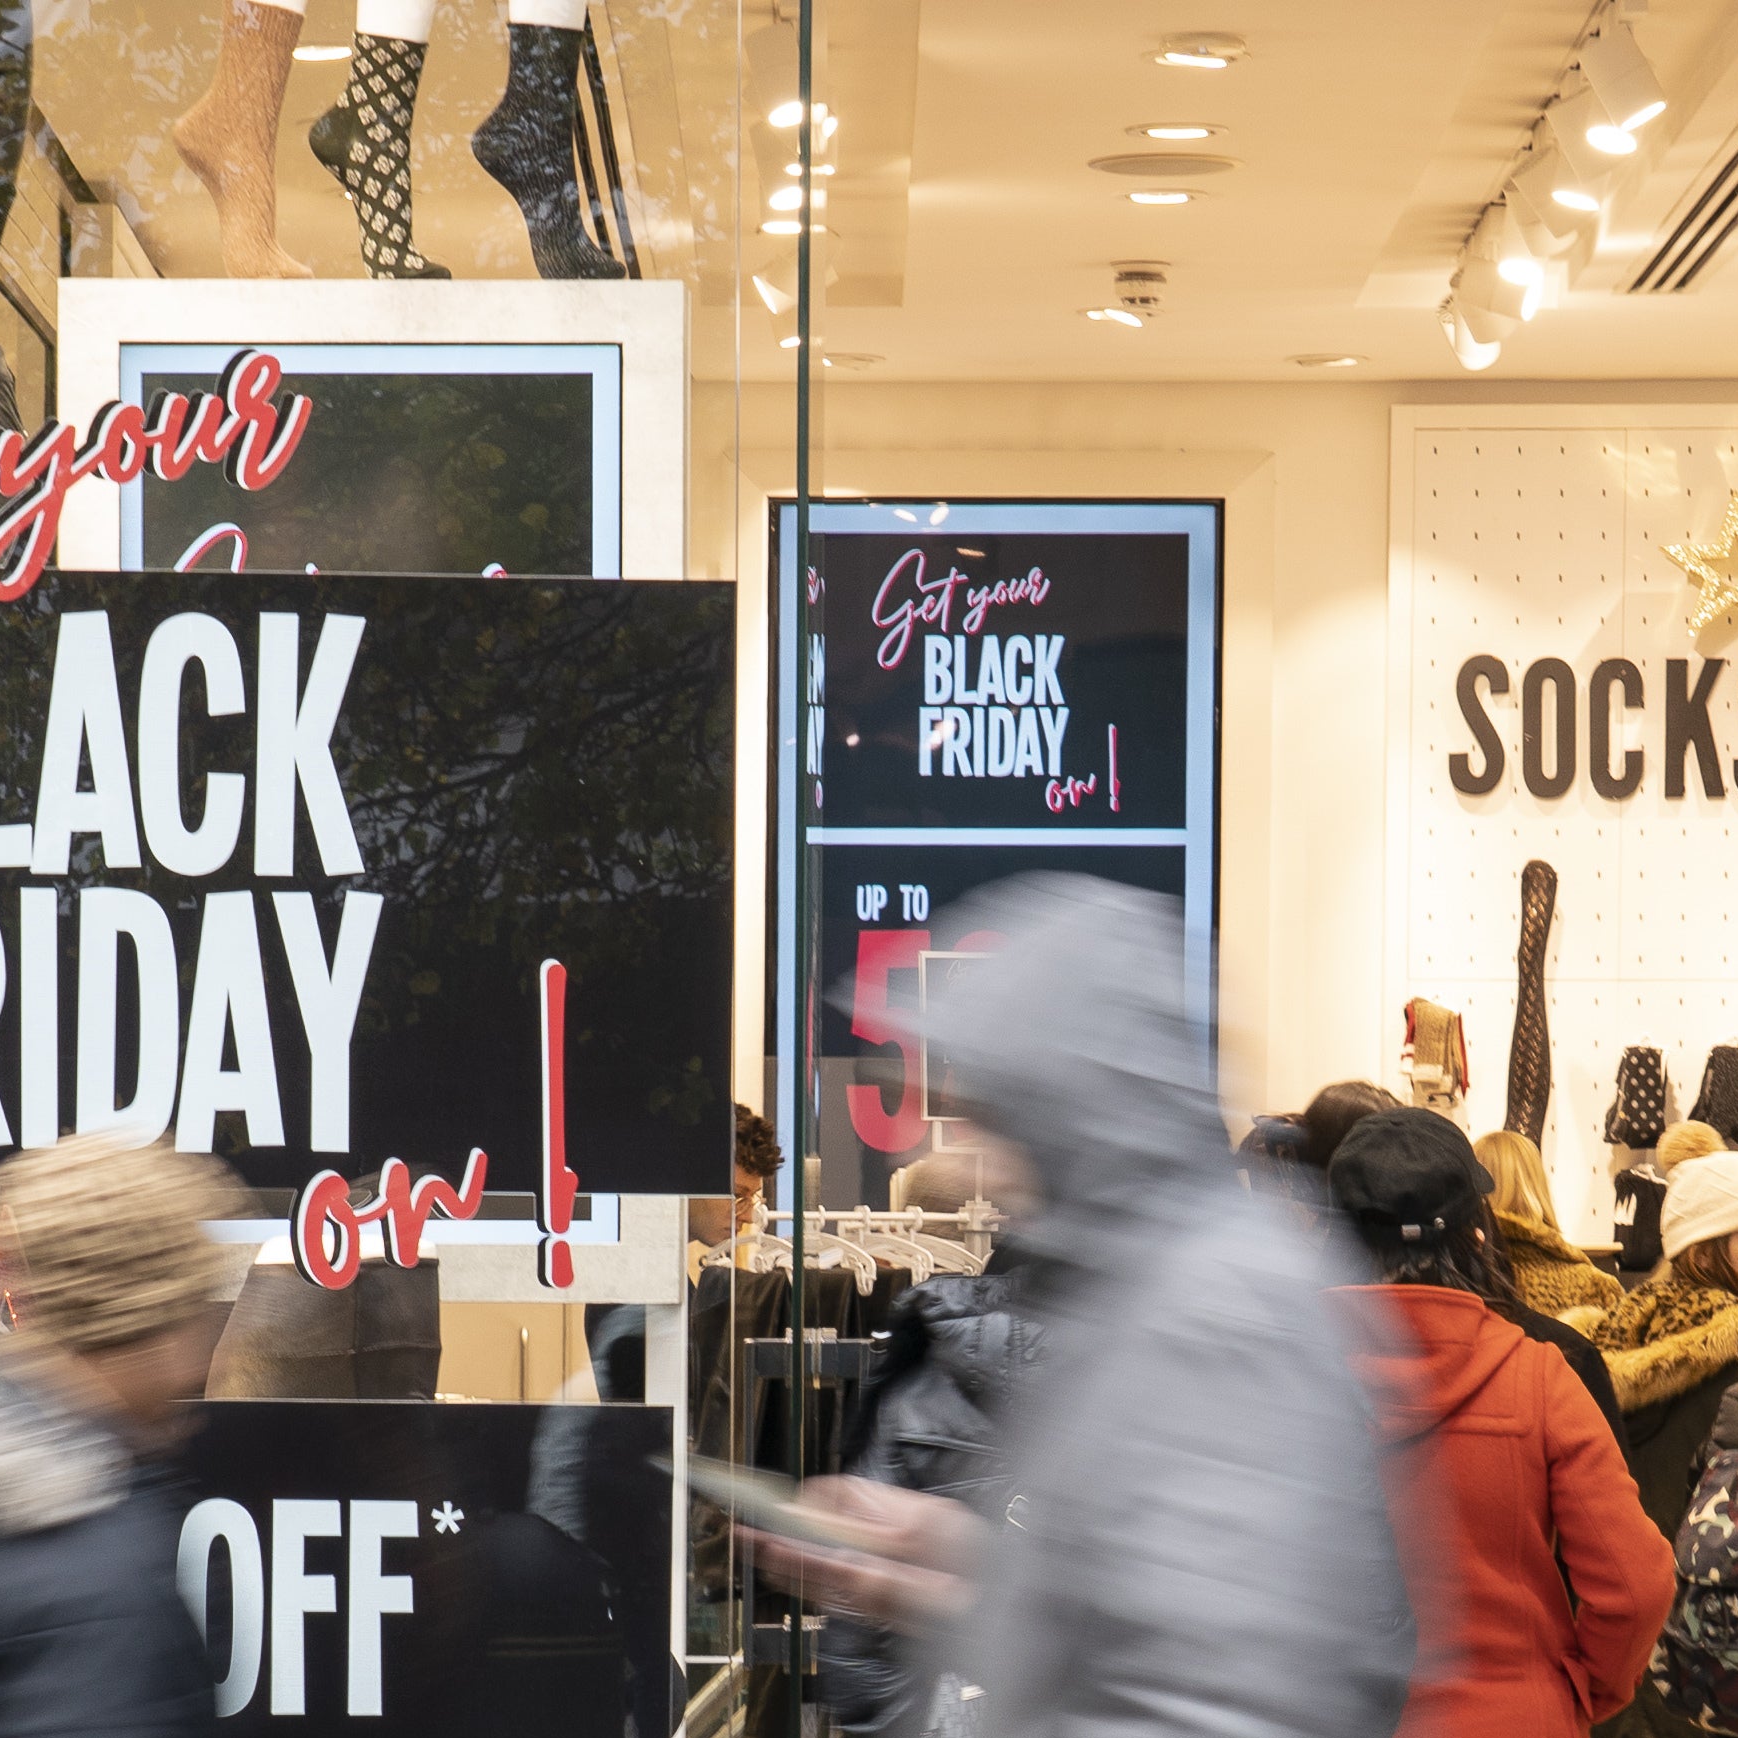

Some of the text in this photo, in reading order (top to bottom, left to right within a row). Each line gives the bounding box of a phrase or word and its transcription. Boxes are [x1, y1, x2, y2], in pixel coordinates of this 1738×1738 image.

[871, 549, 1051, 670] Get your
[924, 634, 1065, 705] BLACK
[919, 707, 1070, 777] FRIDAY
[856, 884, 929, 921] UP TO
